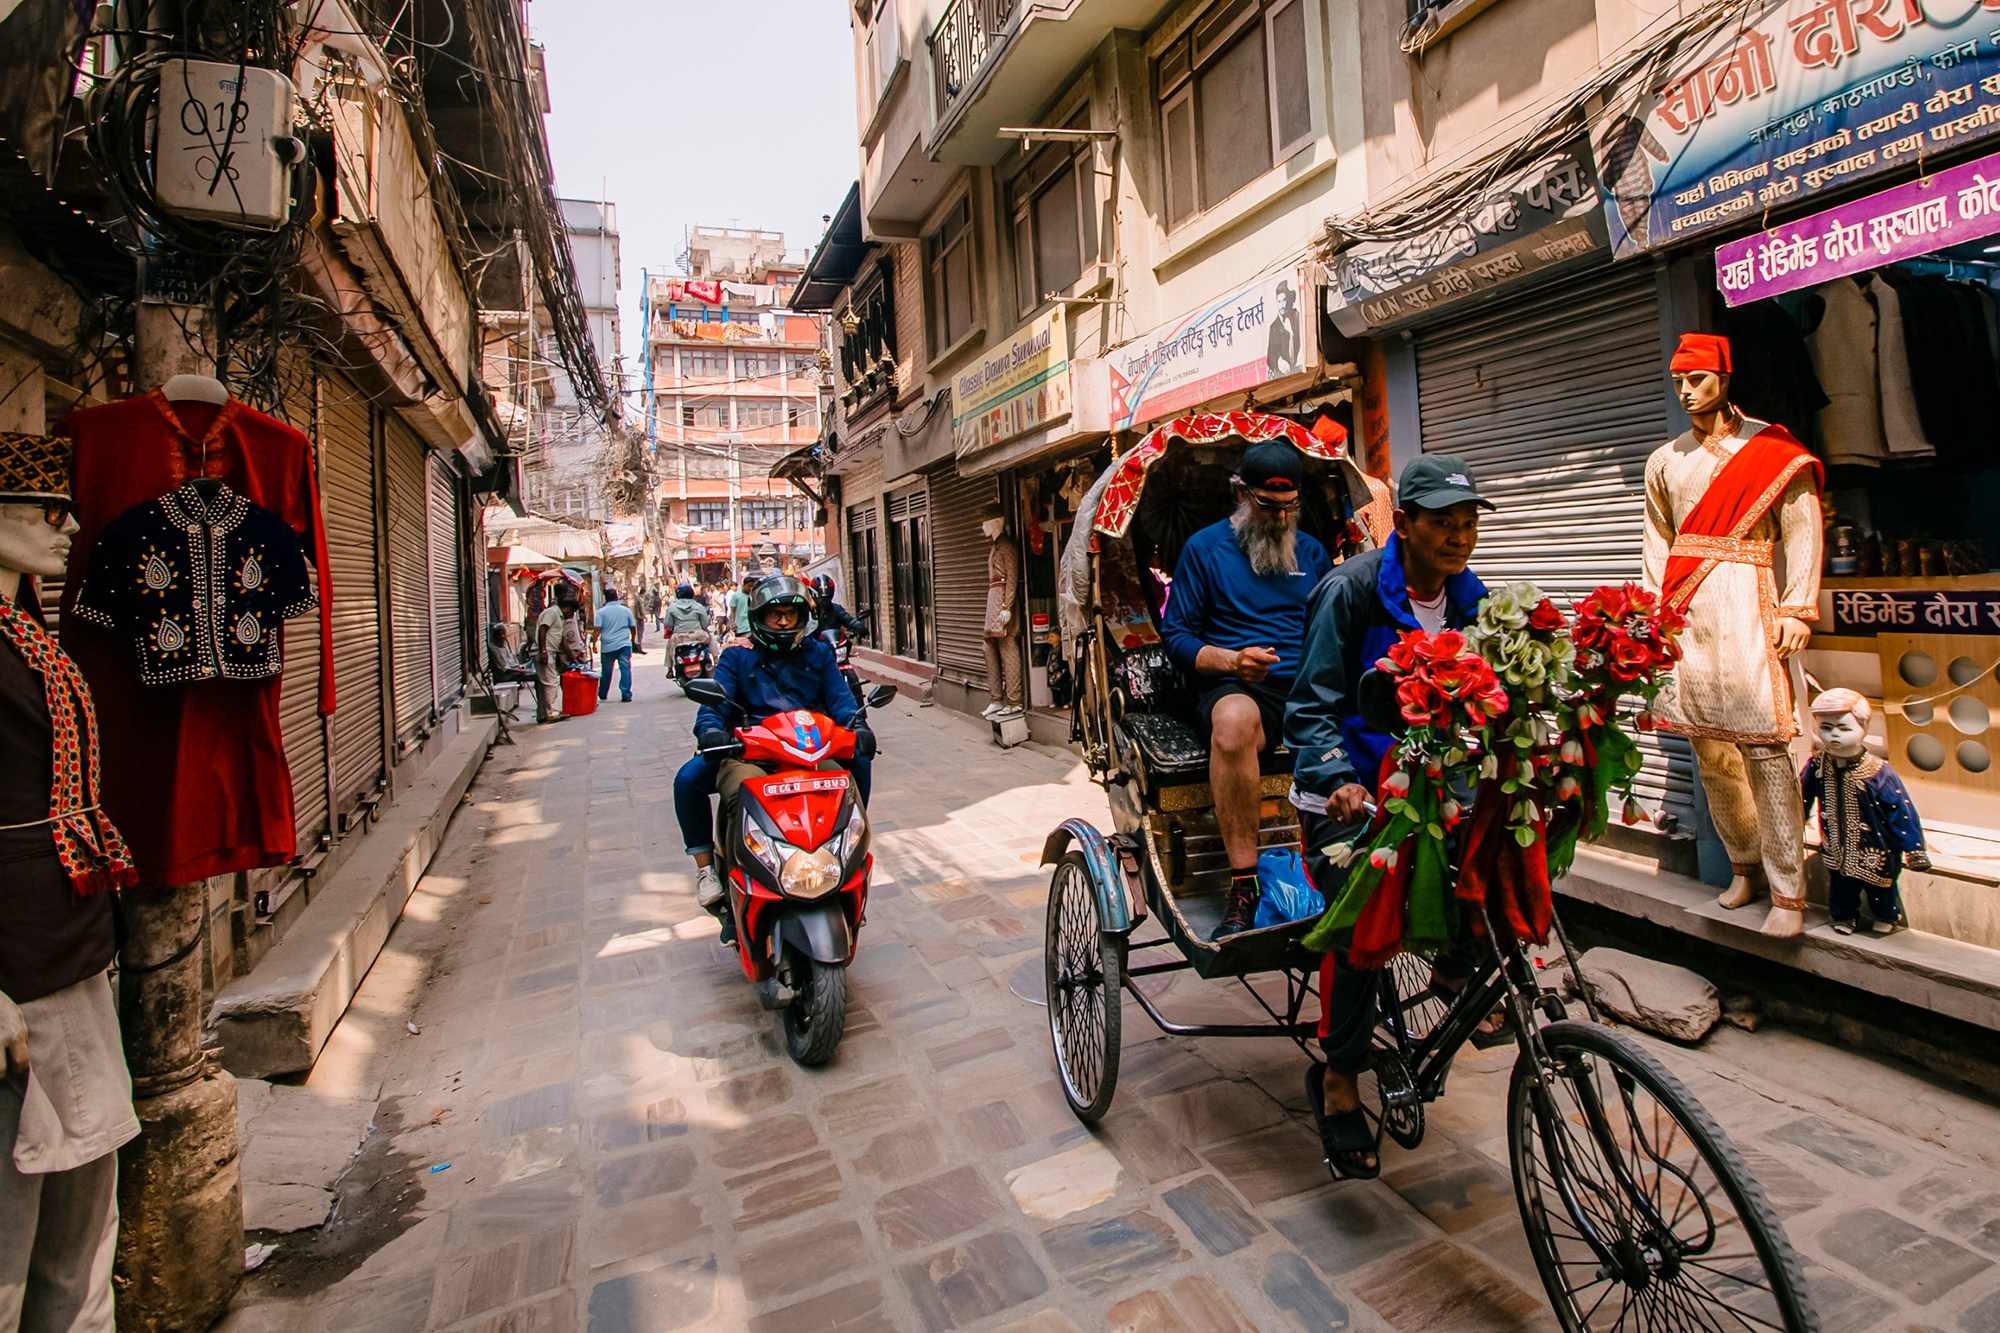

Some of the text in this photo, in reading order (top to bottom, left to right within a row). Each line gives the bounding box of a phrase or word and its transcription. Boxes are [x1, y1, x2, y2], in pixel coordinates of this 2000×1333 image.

[1652, 28, 1777, 134] सानो
[1930, 38, 1978, 70] फोन
[1675, 182, 1706, 206] यहाँ
[1709, 161, 1770, 195] विभिन्न
[1773, 127, 1852, 171] साइजको
[1856, 102, 1920, 141] तयारी
[1924, 83, 1973, 114] दौरा
[1758, 175, 1798, 202] भोटो
[1881, 132, 1925, 160] तथा
[1402, 283, 1434, 309] सुन
[1470, 250, 1524, 280] पसल
[1721, 249, 1755, 290] यहाँ
[1758, 235, 1818, 282] रेडिमेड
[1823, 219, 1864, 262] दौरा
[1237, 296, 1265, 332] टेलर्स
[984, 353, 1010, 384] Daura
[1012, 320, 1051, 368] Suruwal
[1837, 592, 1917, 624] रेडिमेड
[1924, 592, 1978, 627] दौरा
